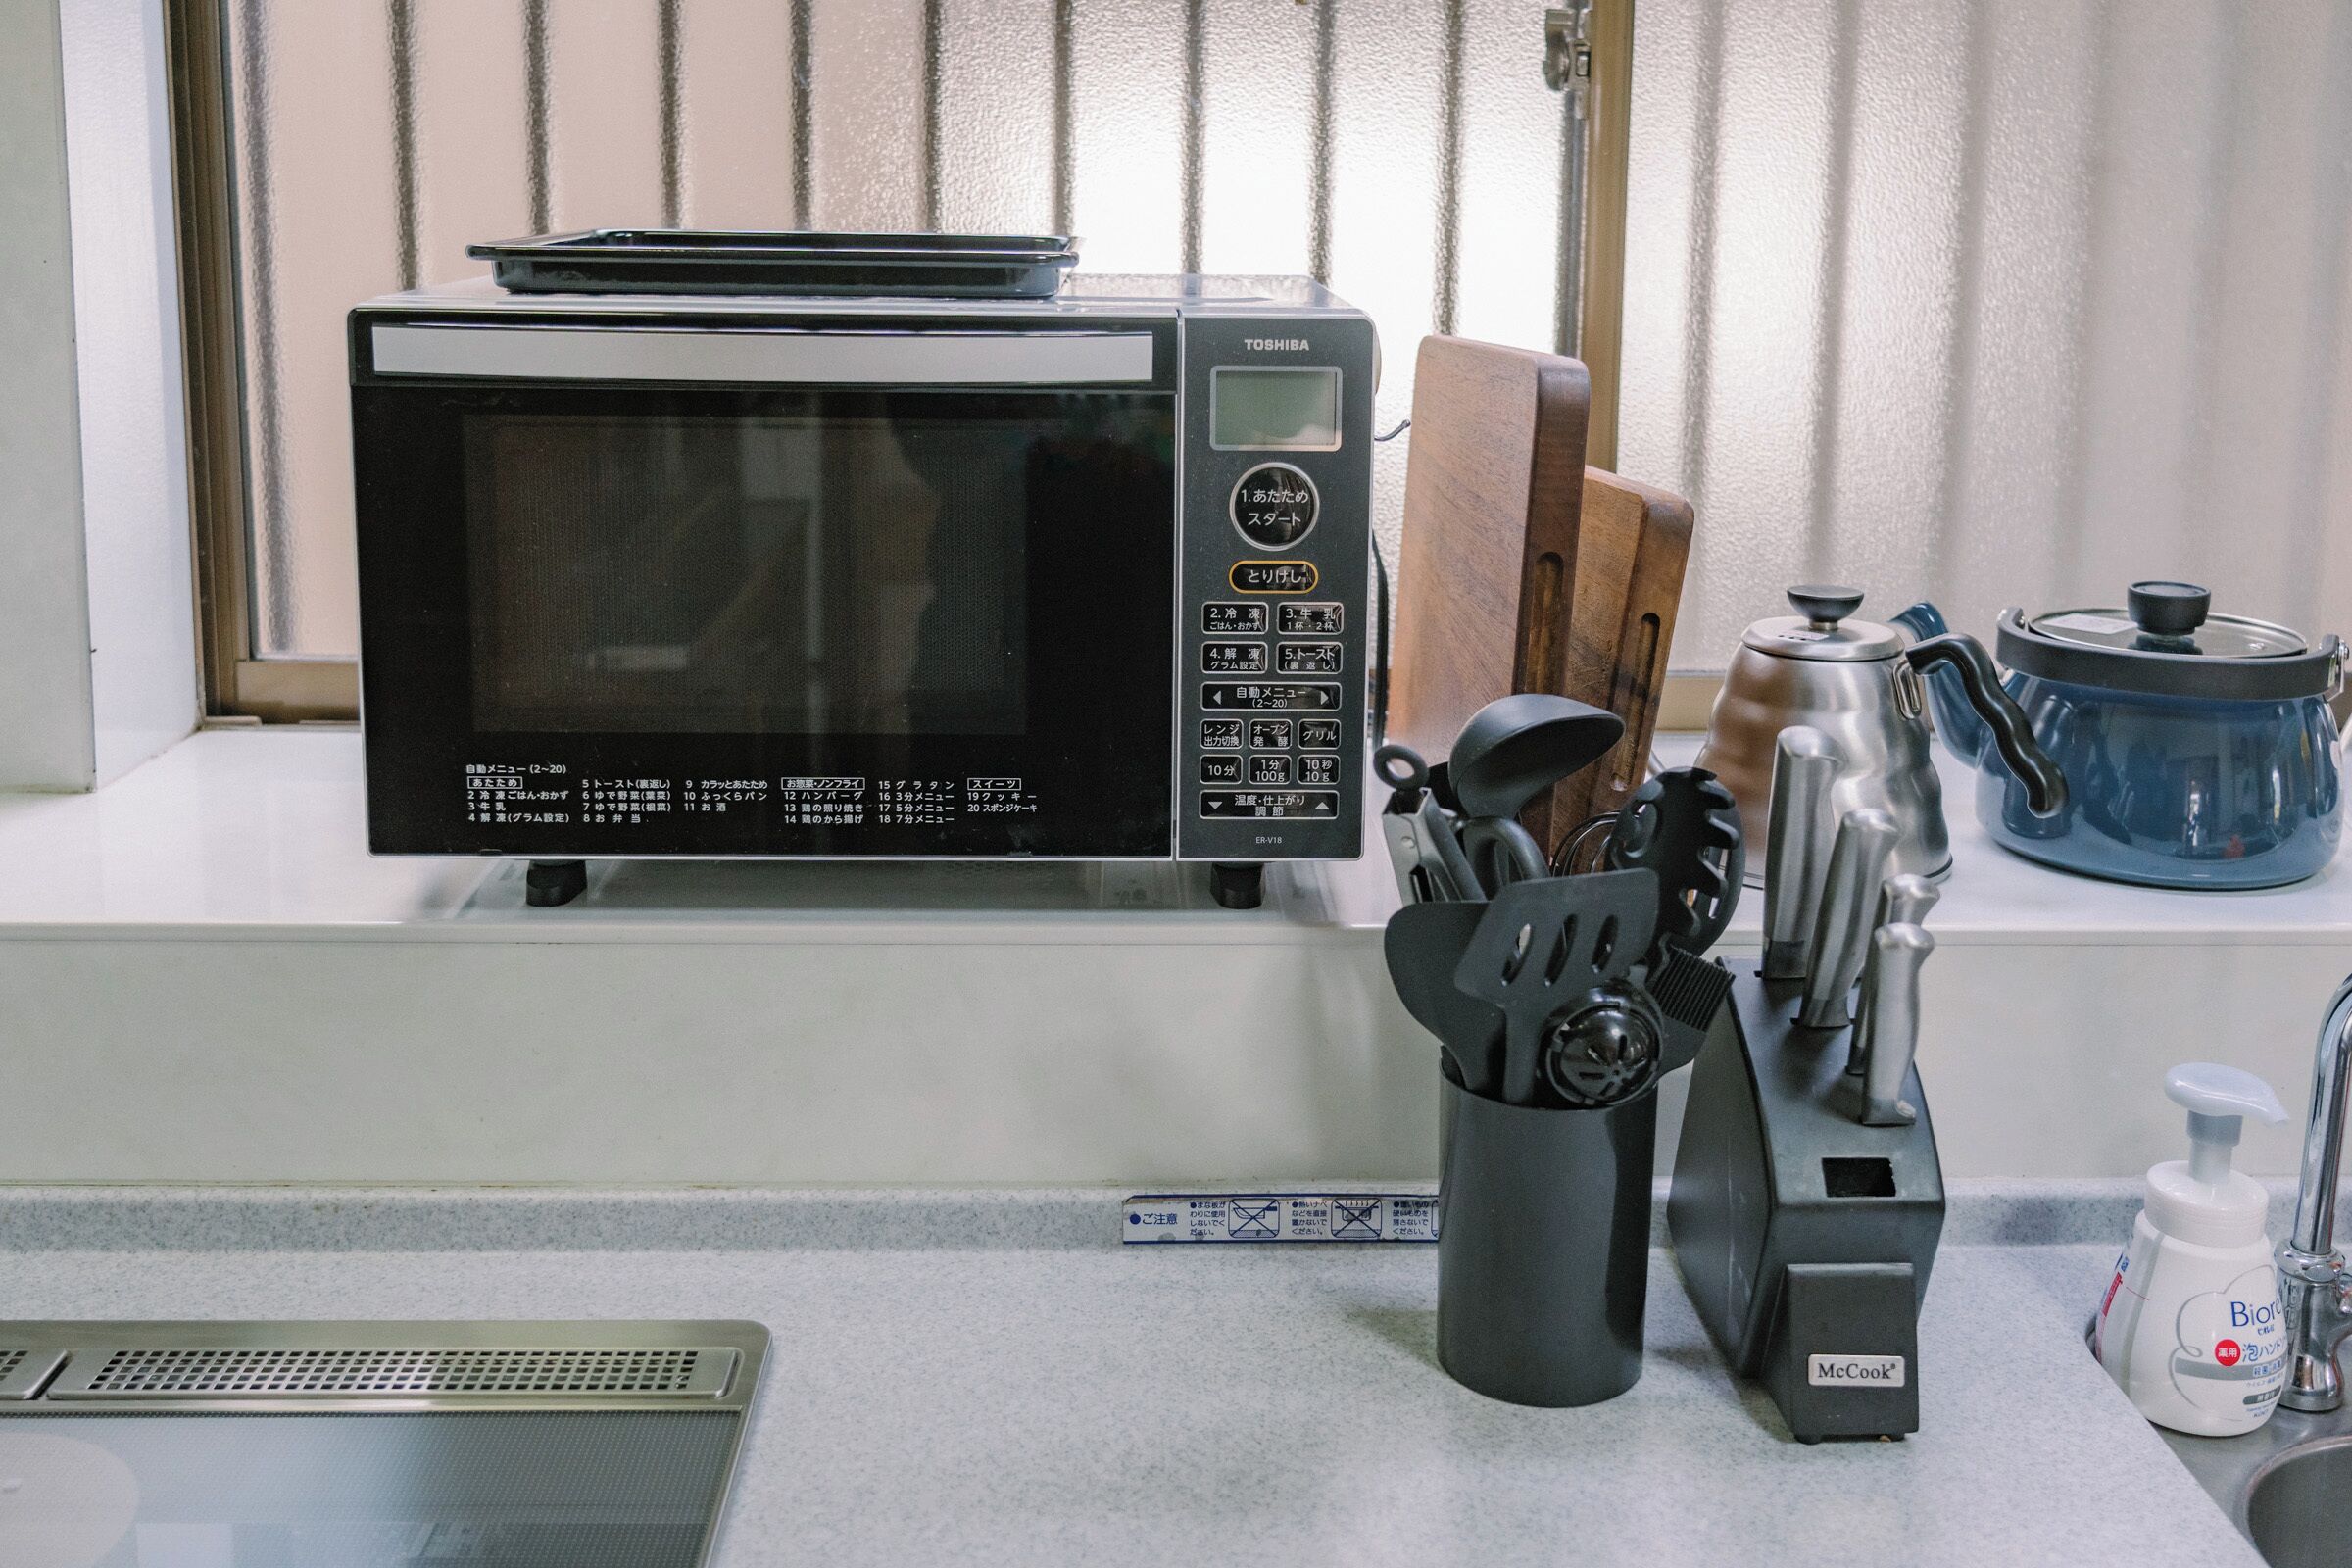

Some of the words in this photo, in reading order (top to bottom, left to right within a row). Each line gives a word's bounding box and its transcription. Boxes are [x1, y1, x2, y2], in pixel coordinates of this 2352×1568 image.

[1244, 339, 1309, 351] TOSHIBA
[1241, 488, 1309, 504] 1.あたため
[1248, 512, 1301, 526] スタート
[1247, 568, 1301, 584] とりけし
[1285, 648, 1336, 660] 5.トースト
[1210, 661, 1259, 670] グラム設定
[1236, 686, 1306, 699] 自動メニュー
[1204, 724, 1240, 735] レンジ
[1253, 724, 1289, 735] オープン
[1302, 730, 1337, 741] グリル
[1204, 736, 1240, 747] 出力切換
[466, 764, 526, 773] 自動メニュー
[1255, 770, 1285, 782] 100g
[472, 778, 517, 787] あたため
[701, 780, 767, 789] カラッとあたため
[896, 780, 955, 790] グラタン
[972, 779, 1017, 789] スイーツ
[701, 791, 767, 801] ふっくらパン
[784, 791, 796, 800] 12
[802, 791, 863, 800] ハンバーグ
[878, 792, 890, 801] 16
[896, 792, 955, 801] 3分メニュー
[967, 792, 979, 801] 19
[982, 792, 1037, 802] クッキー
[467, 802, 475, 810] 3
[480, 802, 506, 810] 牛乳
[701, 803, 726, 812] お酒
[784, 804, 796, 812] 13
[801, 804, 863, 812] 鶏の照り焼き
[896, 804, 955, 812] 5分メニュー
[967, 804, 979, 812] 20
[982, 804, 1037, 813] スポンジケーキ
[1254, 806, 1284, 816] 調節
[468, 813, 475, 822] 4
[595, 814, 641, 823] お弁当
[802, 815, 863, 824] 鶏のから揚げ
[896, 815, 955, 824] 7分メニュー
[1142, 1213, 1178, 1225] ご注意
[2218, 1348, 2238, 1358] 薬用
